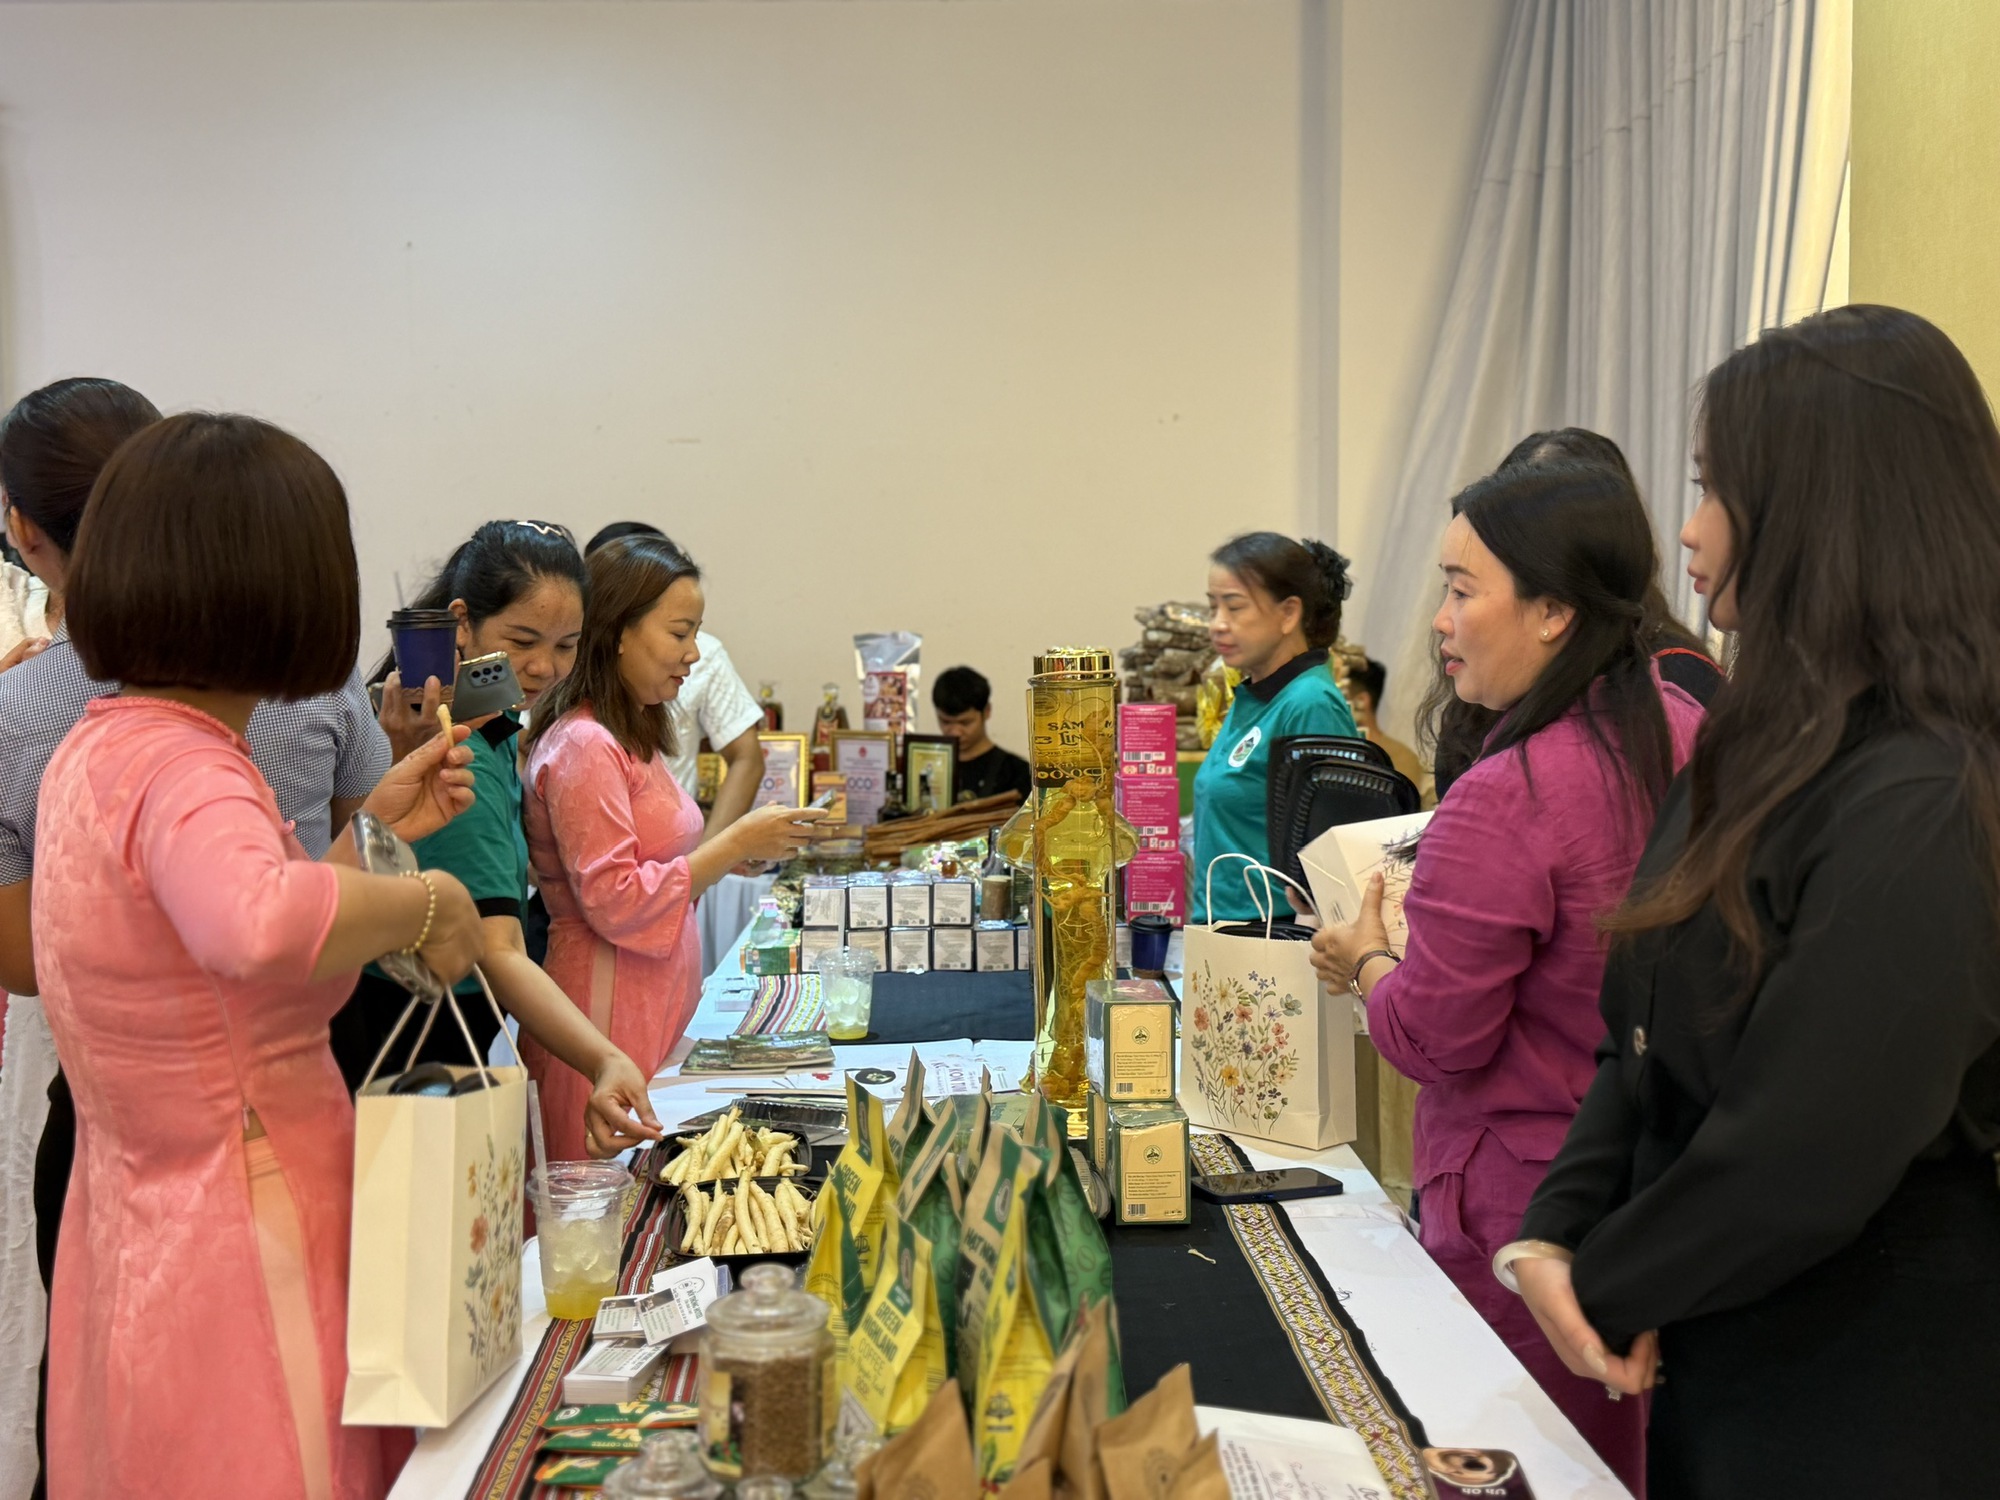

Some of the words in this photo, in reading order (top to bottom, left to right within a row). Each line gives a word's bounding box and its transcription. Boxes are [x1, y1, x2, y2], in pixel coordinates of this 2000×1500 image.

[860, 1312, 899, 1363] HIGHLAND
[874, 1300, 904, 1337] GREEN
[858, 1337, 887, 1377] COFFEE
